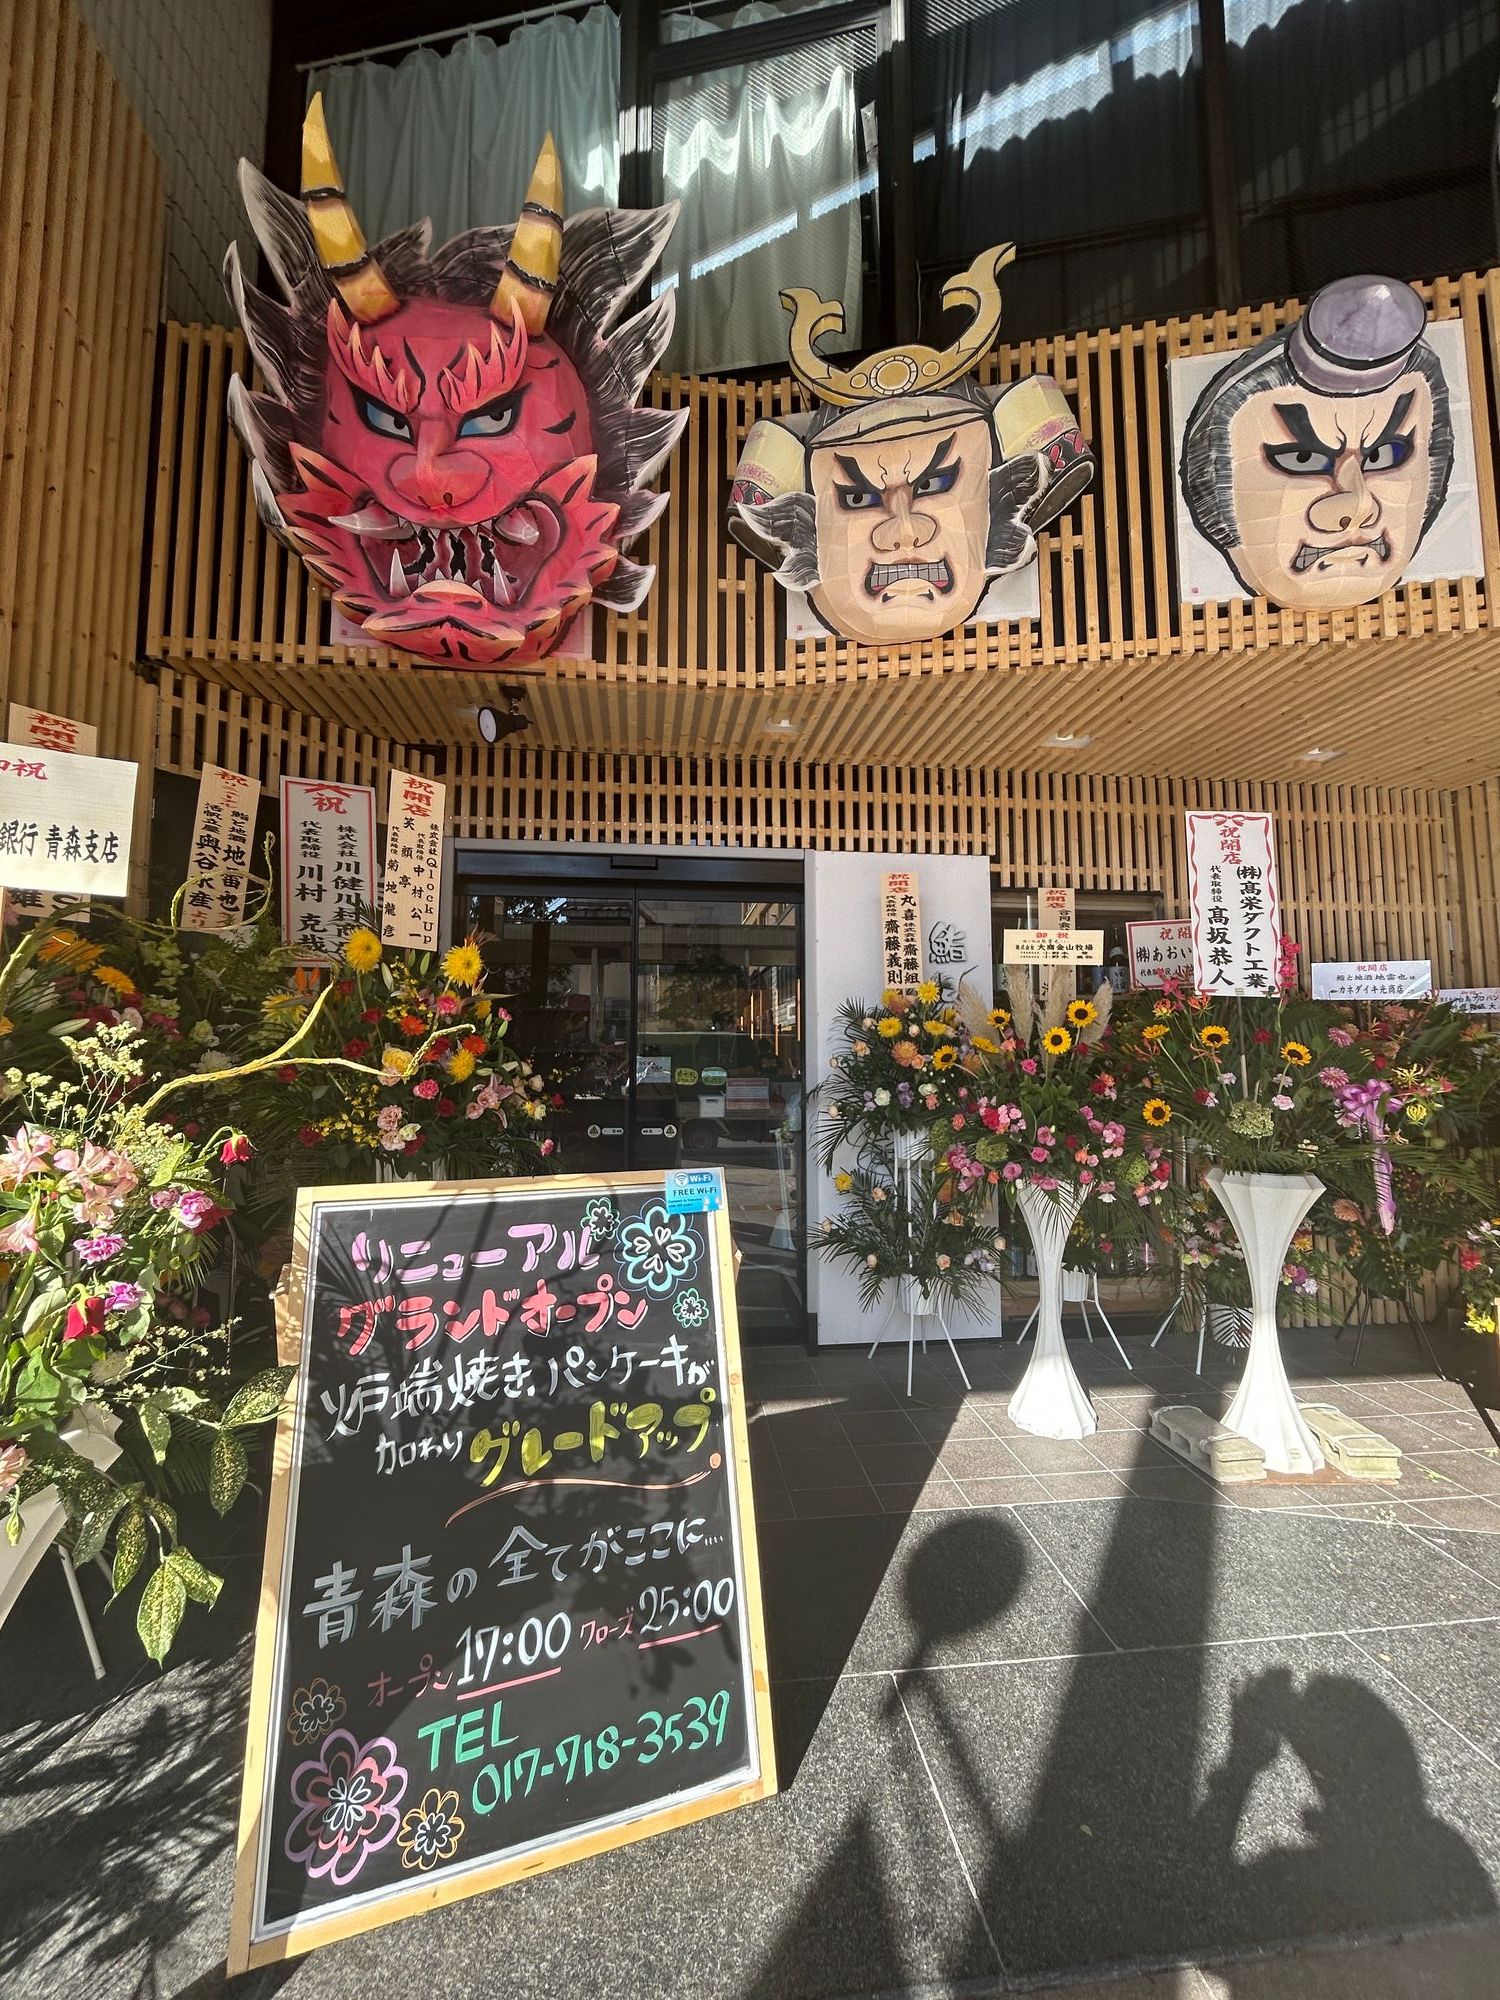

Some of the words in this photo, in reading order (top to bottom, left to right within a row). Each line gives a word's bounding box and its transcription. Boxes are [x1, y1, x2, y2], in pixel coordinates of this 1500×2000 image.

[312, 793, 348, 814] 祝
[402, 776, 435, 818] 祝開店
[45, 824, 119, 864] 青森支店
[1220, 825, 1243, 865] 祝開店
[673, 1188, 695, 1196] FREE
[690, 1174, 711, 1183] Wi-Fi
[351, 1223, 600, 1285] リニューアル
[337, 1273, 649, 1357] グランドオープン
[376, 1430, 463, 1476] 加わり
[470, 1387, 717, 1487] グレードアップ
[367, 1654, 454, 1708] オープン
[456, 1612, 572, 1687] 17:00
[639, 1577, 735, 1635] 25:00
[417, 1700, 519, 1773] TEL
[471, 1688, 731, 1816] 017-718-3539
